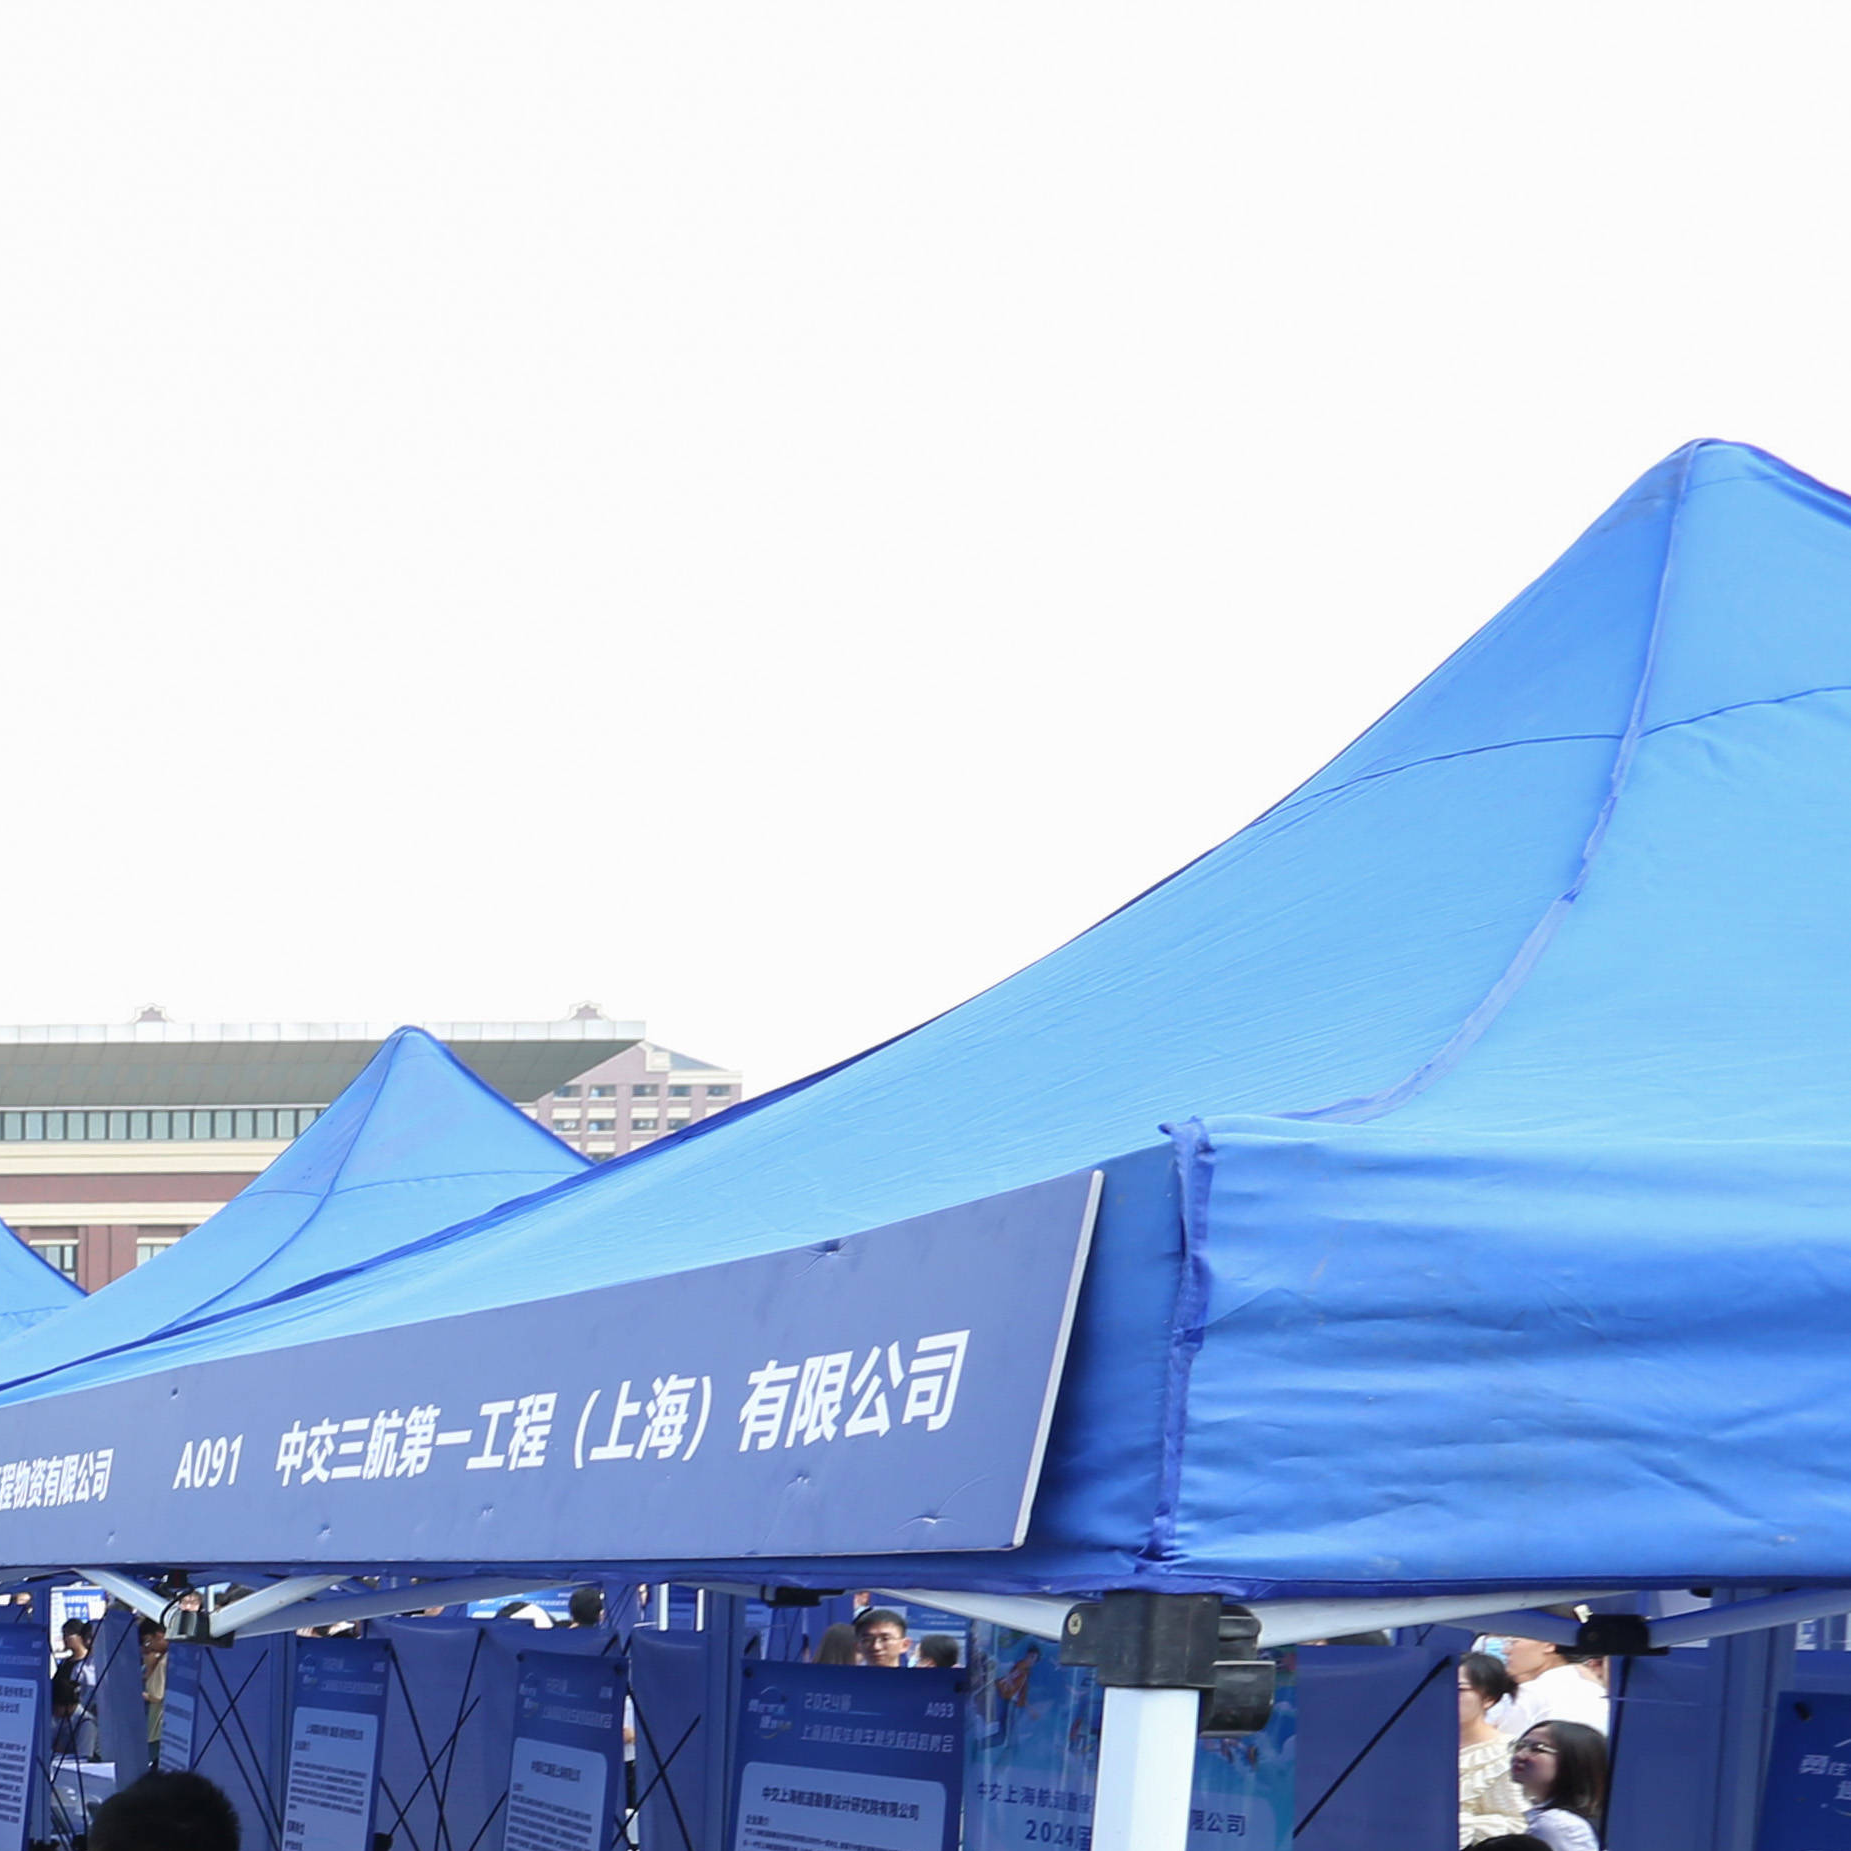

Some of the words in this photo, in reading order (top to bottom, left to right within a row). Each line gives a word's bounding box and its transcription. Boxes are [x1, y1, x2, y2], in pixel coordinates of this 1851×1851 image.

[173, 1432, 244, 1491] A091
[275, 1330, 971, 1488] 中交三航第一工程（上海）有限公司
[925, 1702, 955, 1718] A093
[762, 1785, 921, 1822] 中交上海航道勘察设计研究院有限公司
